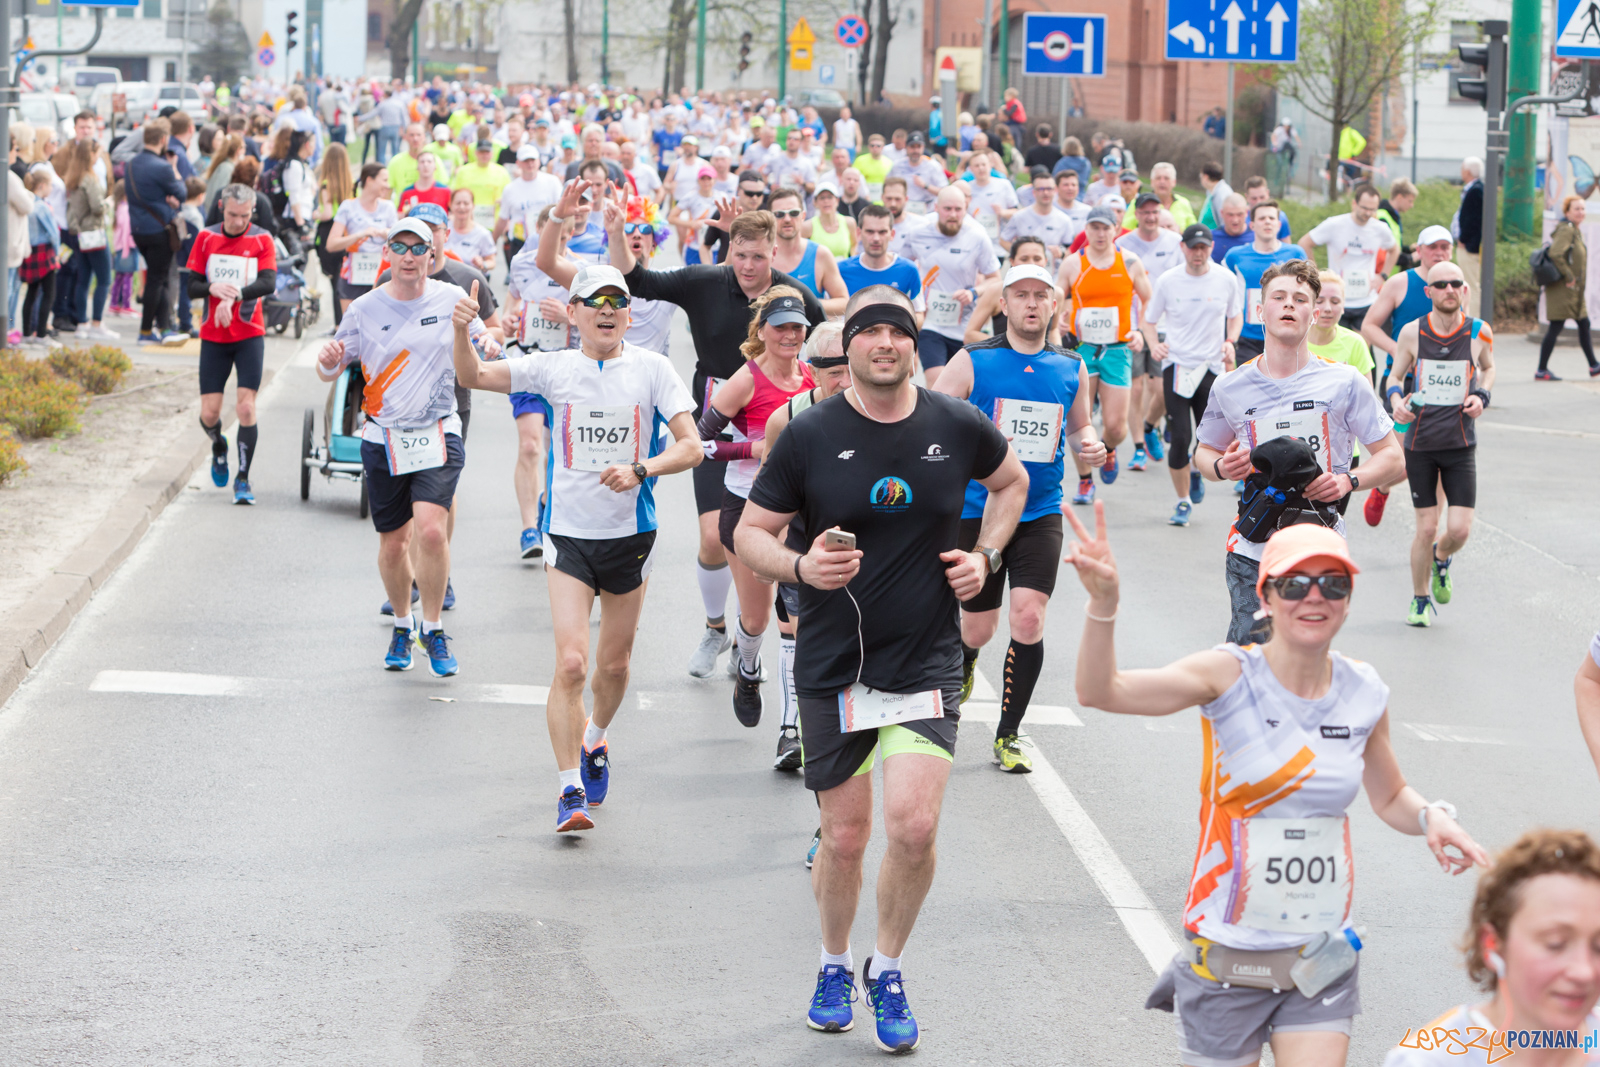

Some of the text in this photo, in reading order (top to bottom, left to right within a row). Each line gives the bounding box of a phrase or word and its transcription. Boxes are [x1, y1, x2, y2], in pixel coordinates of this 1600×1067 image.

[214, 267, 240, 279] 5991
[932, 301, 957, 312] 9527
[532, 317, 561, 330] 8132
[1084, 319, 1112, 329] 4870
[1428, 374, 1462, 387] 5448
[1245, 407, 1258, 416] 4F
[1011, 420, 1049, 437] 1525
[577, 426, 630, 444] 11967
[400, 436, 430, 450] 570
[837, 449, 855, 460] 4F
[1265, 856, 1336, 884] 5001
[1285, 892, 1316, 900] Monika
